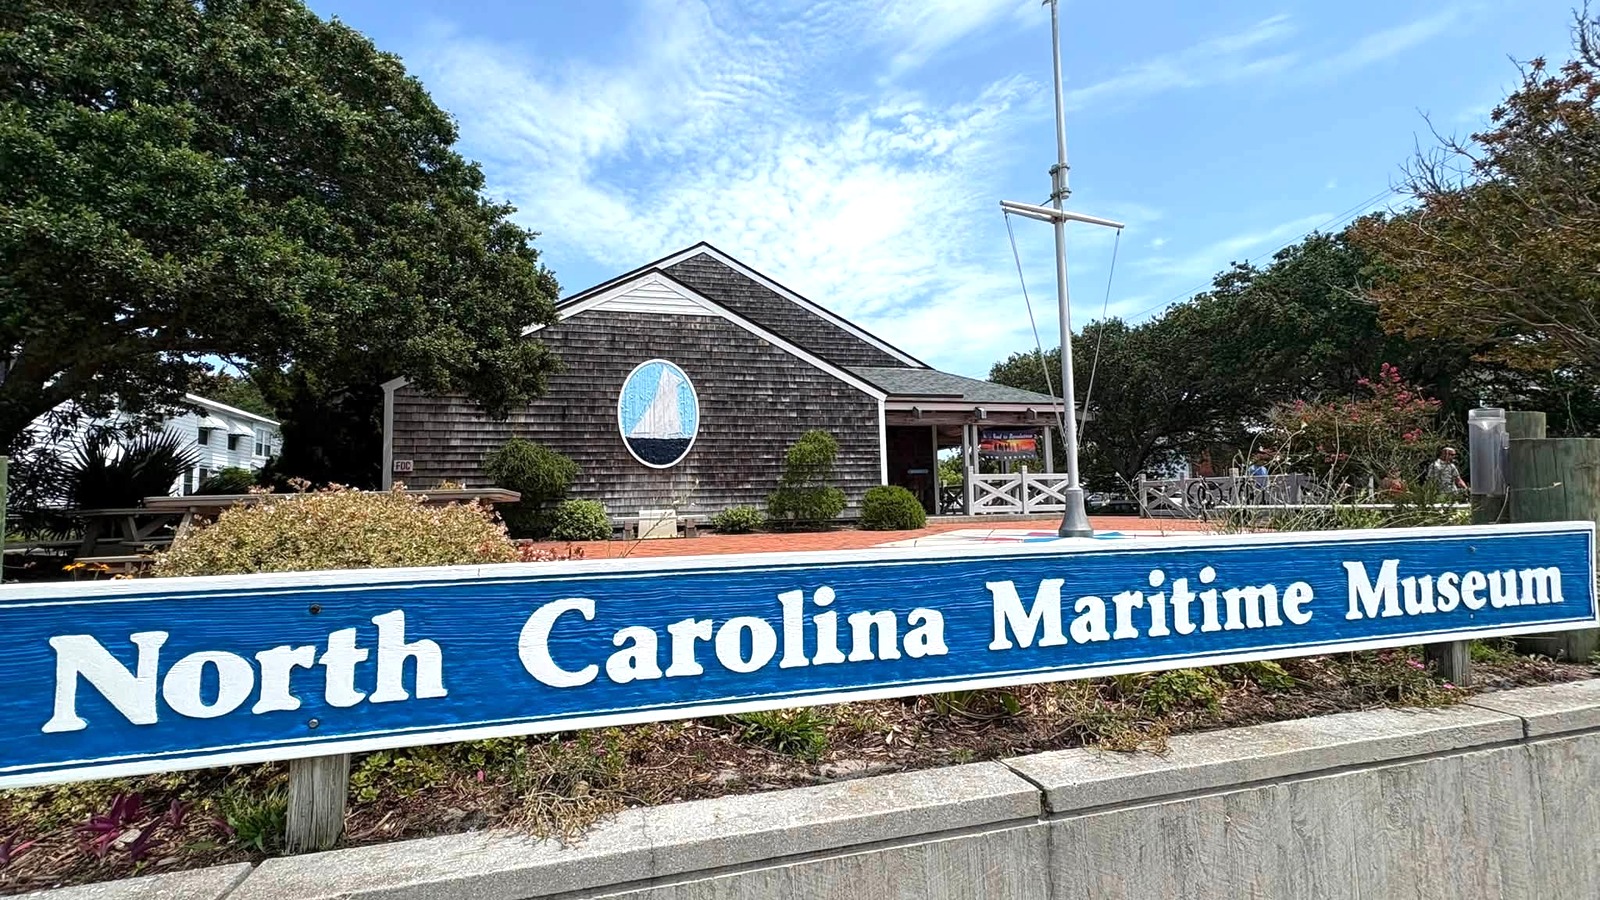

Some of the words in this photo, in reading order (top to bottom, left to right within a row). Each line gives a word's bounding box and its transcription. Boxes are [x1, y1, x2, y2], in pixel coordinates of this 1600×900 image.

[395, 461, 411, 471] FDC
[42, 609, 448, 733] North
[518, 585, 949, 688] Carolina
[985, 566, 1314, 651] Maritime
[1342, 558, 1564, 620] Museum
